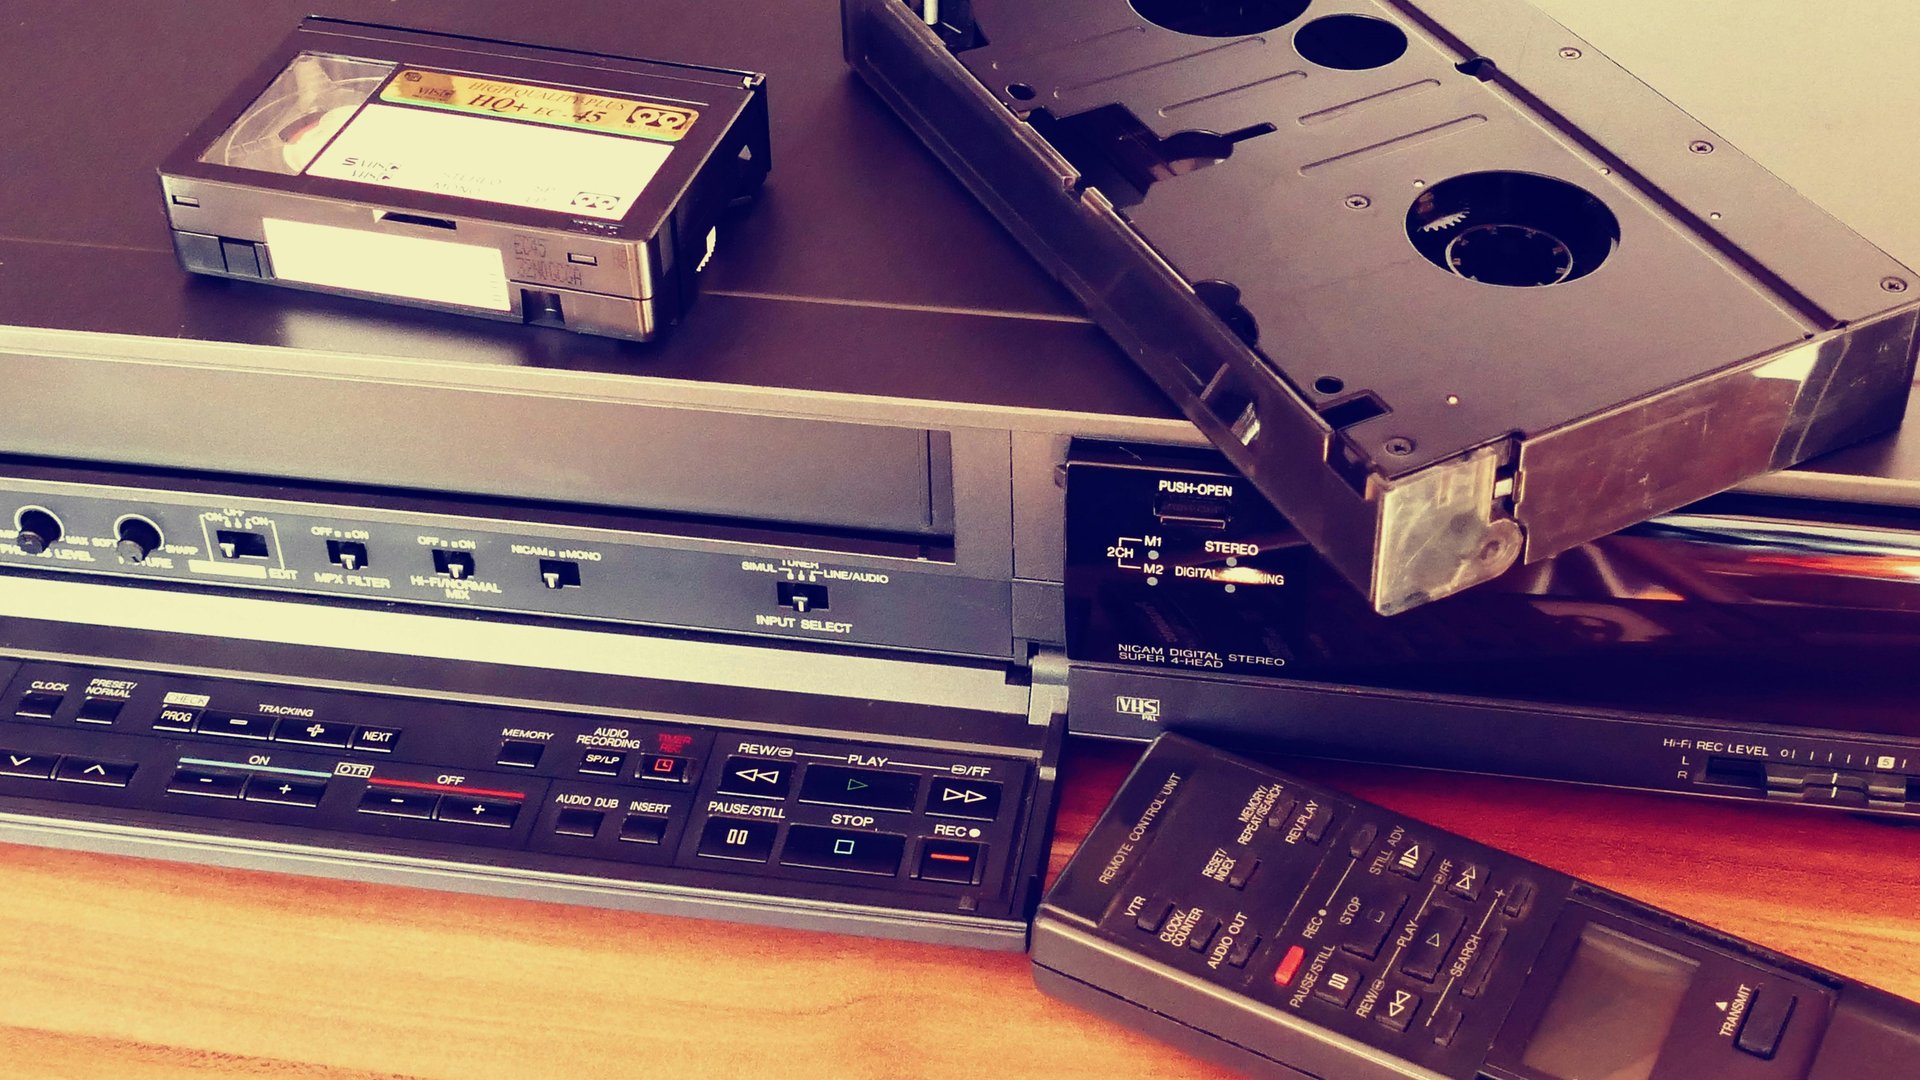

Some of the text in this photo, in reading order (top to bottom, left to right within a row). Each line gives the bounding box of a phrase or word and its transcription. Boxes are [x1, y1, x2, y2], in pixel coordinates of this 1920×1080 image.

[1158, 480, 1233, 498] PUSH-OPEN
[311, 526, 369, 540] OFF ON
[417, 535, 477, 550] OFF ON
[1144, 535, 1162, 548] M1
[1204, 540, 1259, 556] STEREO
[54, 548, 96, 562] LEVEL
[511, 543, 602, 562] NICAM MONO
[1107, 546, 1134, 559] 2CH
[268, 567, 299, 580] EDIT
[741, 560, 778, 573] SIMUL
[1143, 563, 1164, 575] M2
[1175, 565, 1218, 580] DIGITAL
[313, 571, 391, 589] MPX FILTER
[823, 568, 890, 584] LINE/AUDIO
[410, 575, 503, 594] HI-FI/NORMAL
[445, 588, 471, 600] MIX
[755, 614, 853, 634] INPUT SELECT
[1118, 643, 1285, 667] NICAM DIGITAL STEREO
[1118, 651, 1224, 669] SUPER 4-HEAD
[31, 680, 70, 692] CLOCK
[85, 685, 131, 699] NORMAL
[90, 677, 138, 691] PRESET/
[165, 693, 207, 706] CHECK
[1117, 696, 1160, 715] VHS
[160, 709, 193, 723] PROG
[258, 703, 314, 718] TRACKING
[1141, 711, 1158, 722] PAL
[362, 730, 393, 743] NEXT
[501, 727, 555, 741] MEMORY
[594, 726, 629, 739] AUDIO
[576, 733, 641, 749] RECORDING
[1696, 740, 1724, 753] REC
[1727, 743, 1769, 758] LEVEL
[248, 754, 270, 766] ON
[585, 753, 620, 765] SP/LP
[847, 754, 888, 768] PLAY
[1681, 755, 1690, 767] L
[338, 764, 371, 777] OTR
[1676, 769, 1688, 780] R
[437, 773, 465, 787] OFF
[556, 793, 619, 810] AUDIO DUB
[629, 801, 671, 815] INSERT
[1238, 784, 1269, 823] MEMORY/
[707, 800, 786, 820] PAUSE/STILL
[1237, 783, 1284, 846] REPEAT/SEARCH
[831, 813, 874, 829] STOP
[1099, 772, 1182, 885] REMOTE CONTROL UNIT
[934, 824, 968, 838] REC
[1368, 825, 1407, 876] STILL ADV
[1202, 847, 1228, 878] RESET/
[1213, 857, 1237, 882] INDEX
[1124, 895, 1146, 918] VTR
[1339, 896, 1362, 926] STOP
[1159, 909, 1187, 943] CLOCK/
[1171, 907, 1205, 948] COUNTER
[1302, 916, 1324, 940] REC
[1397, 919, 1419, 948] PLAY
[1207, 911, 1249, 970] AUDIO OUT
[1450, 933, 1482, 979] SEARCH
[1289, 944, 1336, 1009] PAUSE/STILL
[1718, 983, 1752, 1038] TRANSMIT
